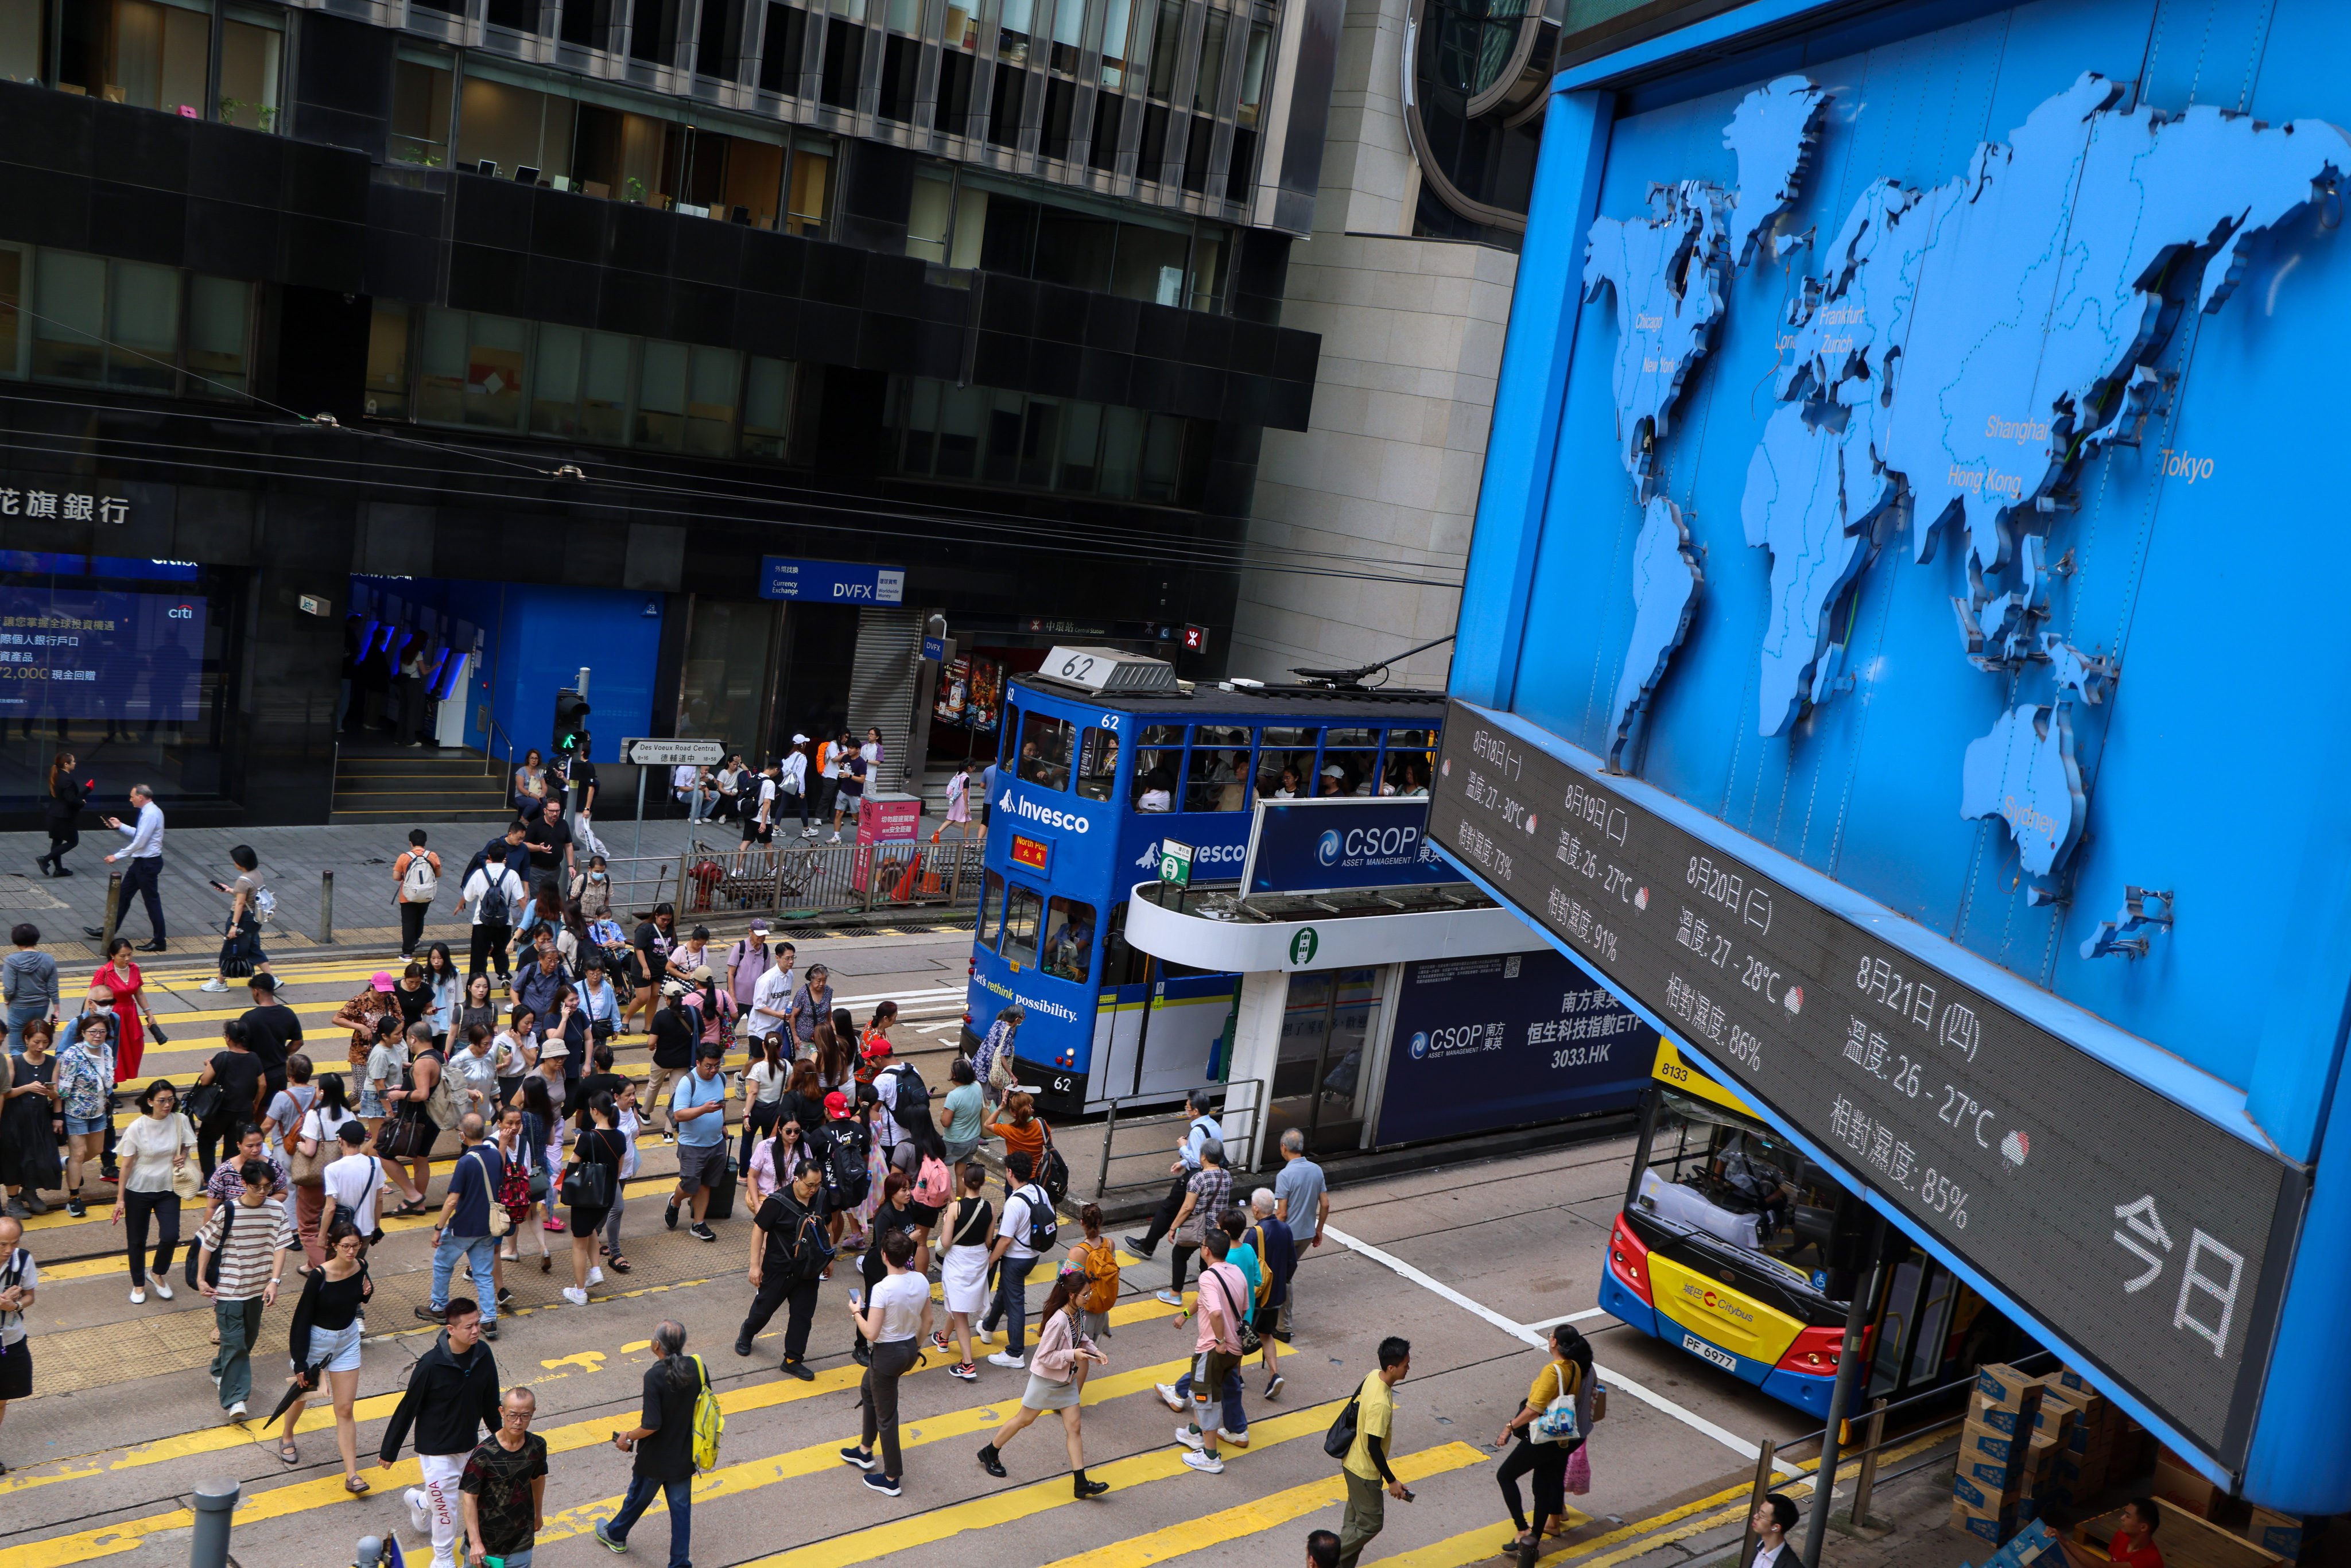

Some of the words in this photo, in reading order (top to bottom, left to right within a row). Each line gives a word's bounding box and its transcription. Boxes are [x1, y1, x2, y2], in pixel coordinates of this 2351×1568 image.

[1635, 313, 1663, 333] Chicago
[1819, 305, 1865, 325] Frankfurt
[1821, 334, 1852, 354] Zurich
[1642, 357, 1659, 372] New
[1659, 357, 1676, 374] York
[1985, 415, 2050, 445] Shanghai
[2160, 448, 2214, 484] Tokyo
[1947, 464, 1984, 493] Hong
[1984, 468, 2022, 499] Kong
[0, 487, 130, 524] 花旗銀行
[775, 566, 798, 574] 外幣找換
[773, 580, 797, 589] Currency
[773, 587, 798, 596] Exchange
[833, 583, 872, 599] DVFX
[168, 605, 193, 619] citi
[1046, 620, 1074, 632] 中環站
[927, 642, 941, 652] DVFX
[52, 670, 96, 681] 現金回贈
[1061, 655, 1094, 681] 62
[1007, 688, 1014, 701] 62
[1101, 714, 1119, 729] 62
[661, 754, 695, 762] 德輔道中
[1473, 731, 1506, 769] 8月18日
[1504, 750, 1522, 781] (一)
[1485, 786, 1497, 810] 27
[1018, 794, 1089, 834] Invesco
[1565, 785, 1607, 830] 8月19日
[1606, 808, 1628, 847] (二)
[2003, 794, 2059, 842] Sydney
[1017, 836, 1033, 848] North
[1345, 827, 1417, 856] CSOP
[1367, 857, 1411, 865] MANAGEMENT
[1493, 849, 1512, 881] 73%
[1582, 850, 1597, 879] 26
[1686, 856, 1743, 914] 8月20日
[1744, 888, 1772, 936] (三)
[1593, 924, 1619, 962] 91%
[1711, 935, 1732, 968] 27
[987, 981, 1014, 1000] rethink
[1015, 993, 1077, 1023] possibility.
[1856, 956, 1937, 1031] 8月21日
[1939, 1003, 1980, 1063] (四)
[1430, 1024, 1483, 1051] CSOP
[1485, 1022, 1506, 1037] 南方
[1446, 1046, 1479, 1056] MANAGEMENT
[1483, 1035, 1503, 1051] 東英
[1551, 1043, 1612, 1069] 3033.HK
[1729, 1024, 1763, 1072] 86%
[1054, 1077, 1072, 1092] 62
[1662, 1063, 1688, 1082] 8133
[1892, 1054, 1922, 1099] 26
[1922, 1167, 1969, 1231] 85%
[2112, 1194, 2244, 1359] 今日
[1683, 1283, 1703, 1299] 城巴
[1718, 1299, 1754, 1322] Citybus
[1686, 1338, 1701, 1350] PF
[1704, 1348, 1733, 1367] 6977
[429, 1481, 451, 1524] CANADA
